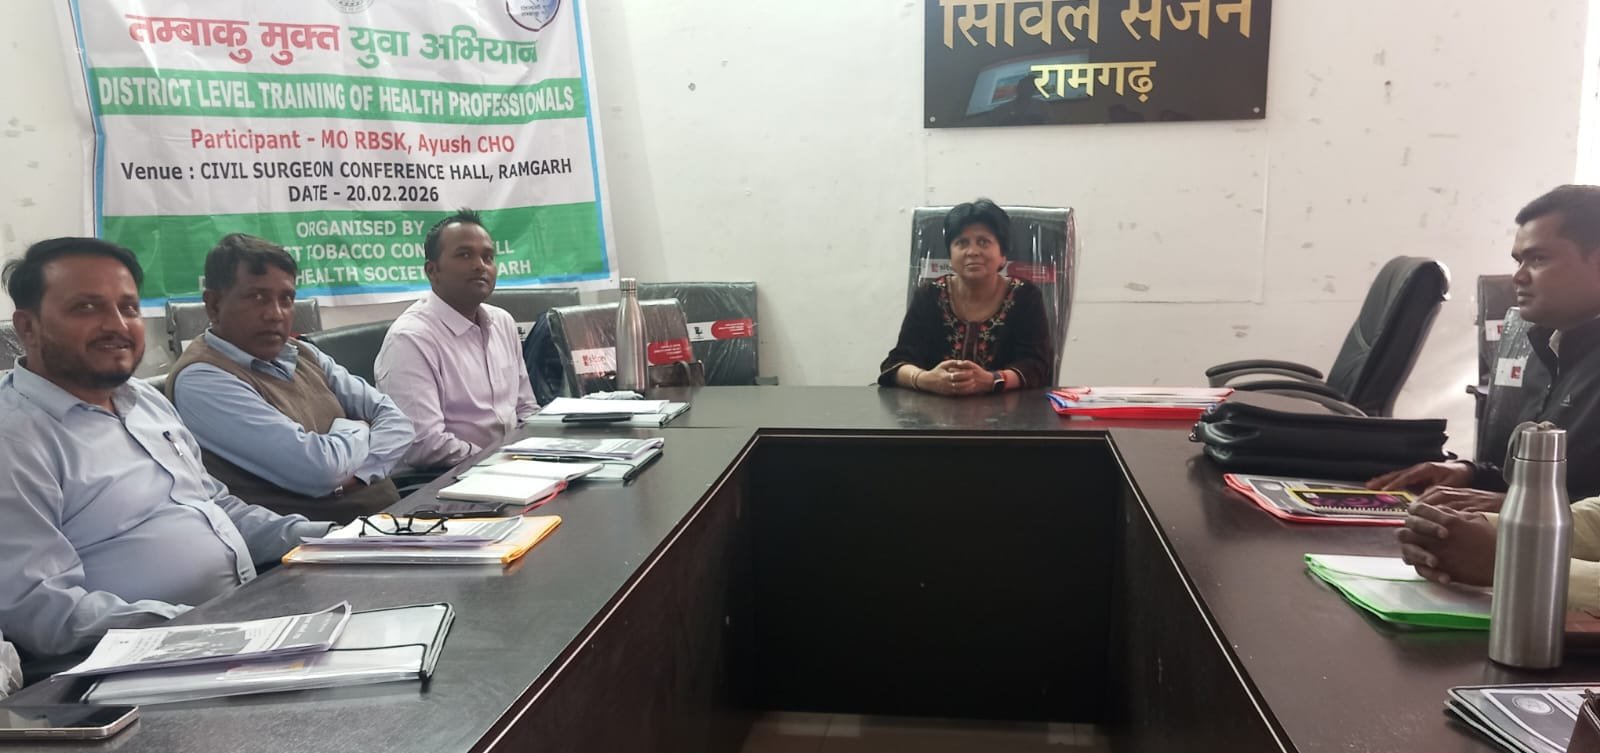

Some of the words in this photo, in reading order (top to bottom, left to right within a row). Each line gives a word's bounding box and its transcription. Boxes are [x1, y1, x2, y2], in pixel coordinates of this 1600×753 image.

[125, 14, 252, 64] तम्बाकु
[258, 22, 340, 66] मुक्त
[349, 26, 410, 69] युवा
[419, 24, 539, 65] अभियान
[1031, 61, 1157, 102] रामगढ़
[99, 77, 191, 107] DISTRICT
[197, 79, 256, 109] LEVEL
[258, 82, 345, 110] TRAINING
[350, 85, 375, 112] OF
[379, 83, 444, 115] HEALTH
[449, 86, 574, 117] PROFESSIONALS
[191, 129, 301, 153] Participant
[321, 130, 348, 149] MO
[355, 131, 412, 154] RBSK,
[418, 134, 471, 156] Ayush
[477, 135, 515, 153] CHO
[121, 162, 182, 179] Venue
[200, 162, 248, 179] CIVIL
[253, 161, 334, 178] SURGEON
[339, 162, 445, 180] CONFERENCE
[450, 164, 494, 182] HALL,
[499, 158, 572, 179] RAMGARH
[289, 185, 327, 202] DATE
[347, 185, 439, 202] 20.02.2026
[296, 220, 396, 238] ORGANISED
[403, 220, 424, 236] BY
[306, 243, 385, 261] TOBACCO
[296, 266, 358, 286] HEALTH
[364, 265, 428, 281] SOCIET
